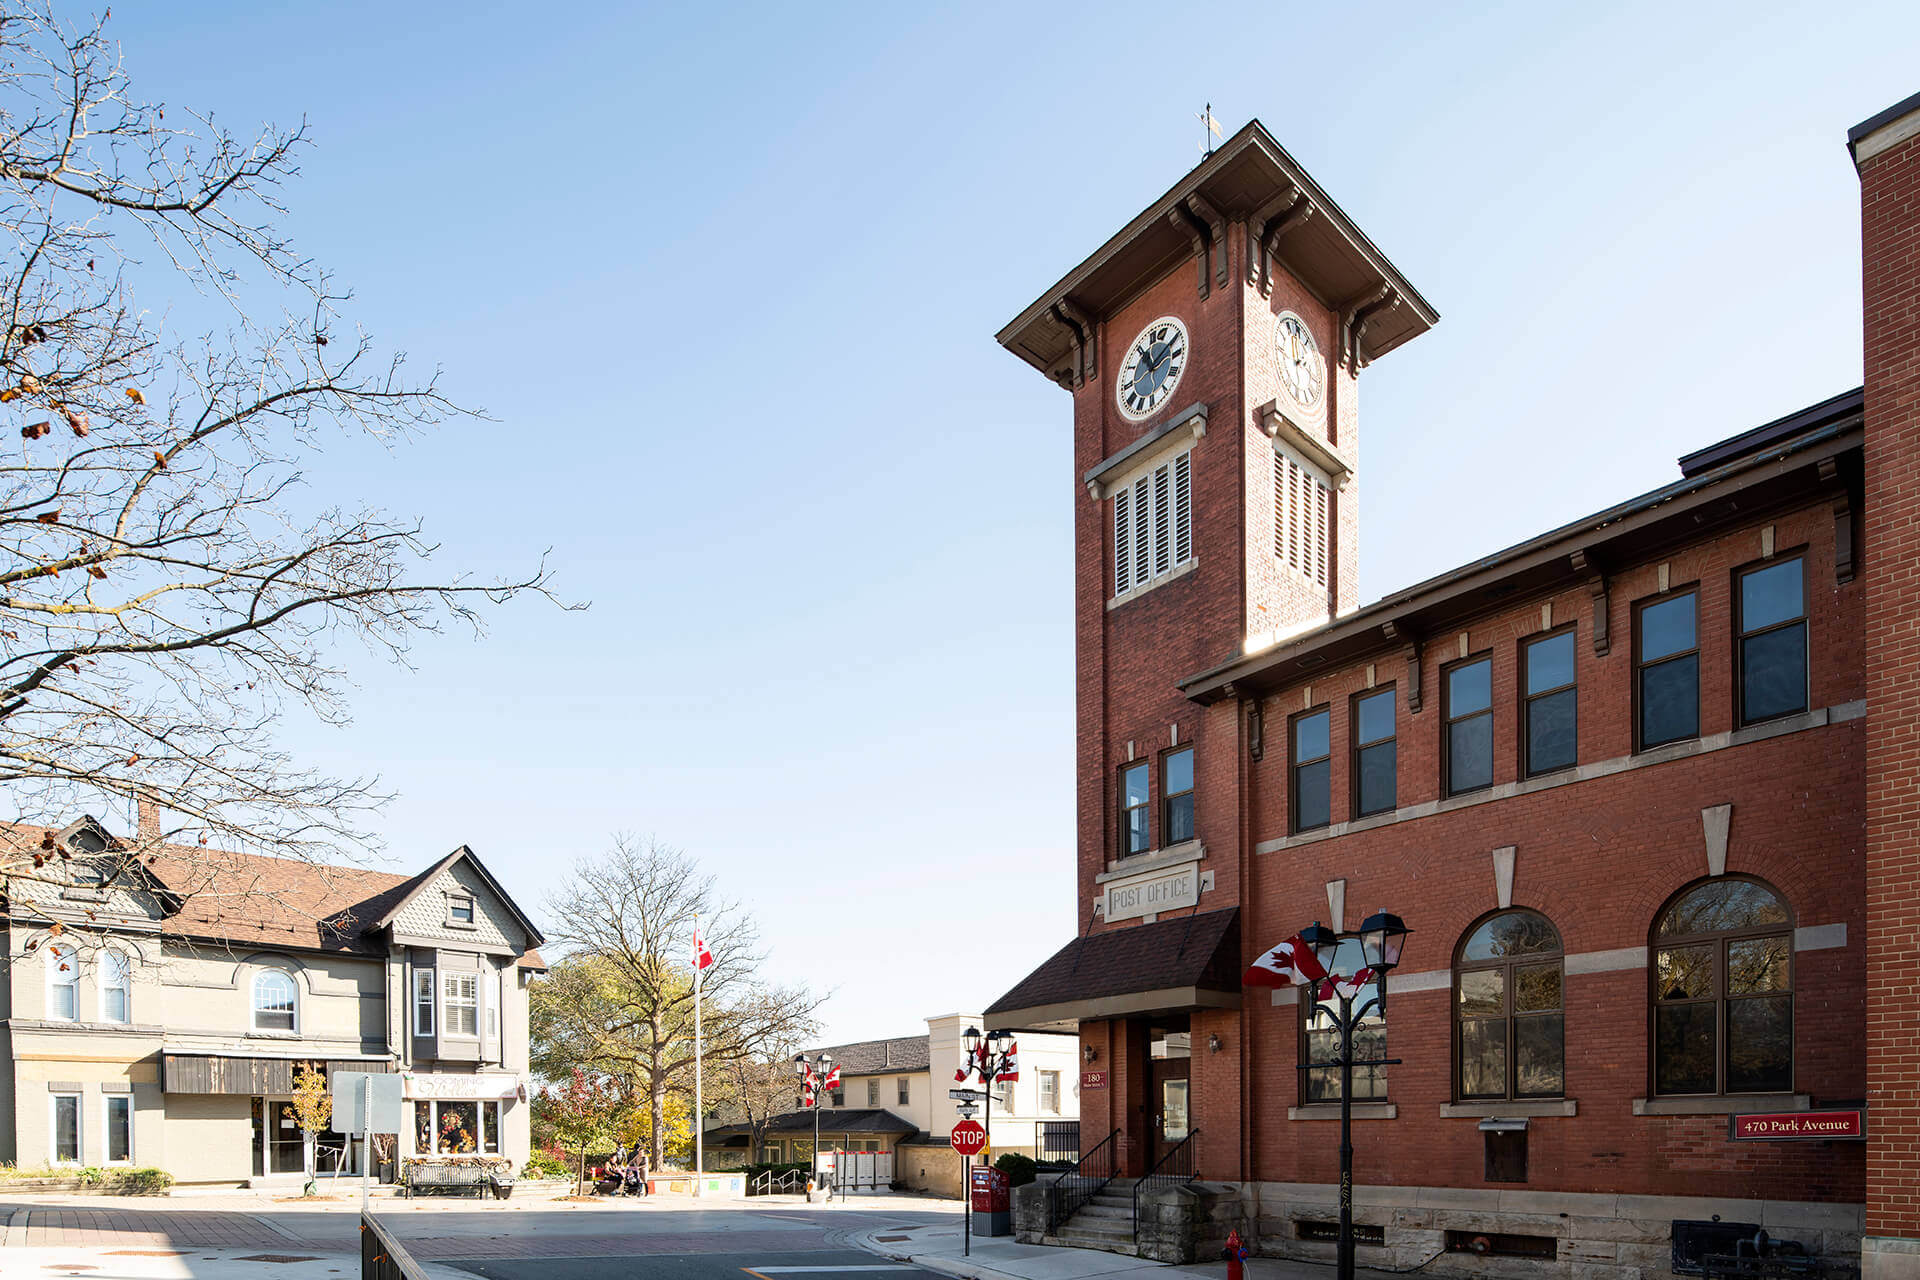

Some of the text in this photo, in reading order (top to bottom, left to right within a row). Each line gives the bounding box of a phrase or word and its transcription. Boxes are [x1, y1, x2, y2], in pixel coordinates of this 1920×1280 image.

[1113, 876, 1189, 910] POST OFFICE
[1088, 1073, 1100, 1082] 180
[1744, 1120, 1850, 1132] 470 Park Avenue
[953, 1130, 984, 1145] STOP
